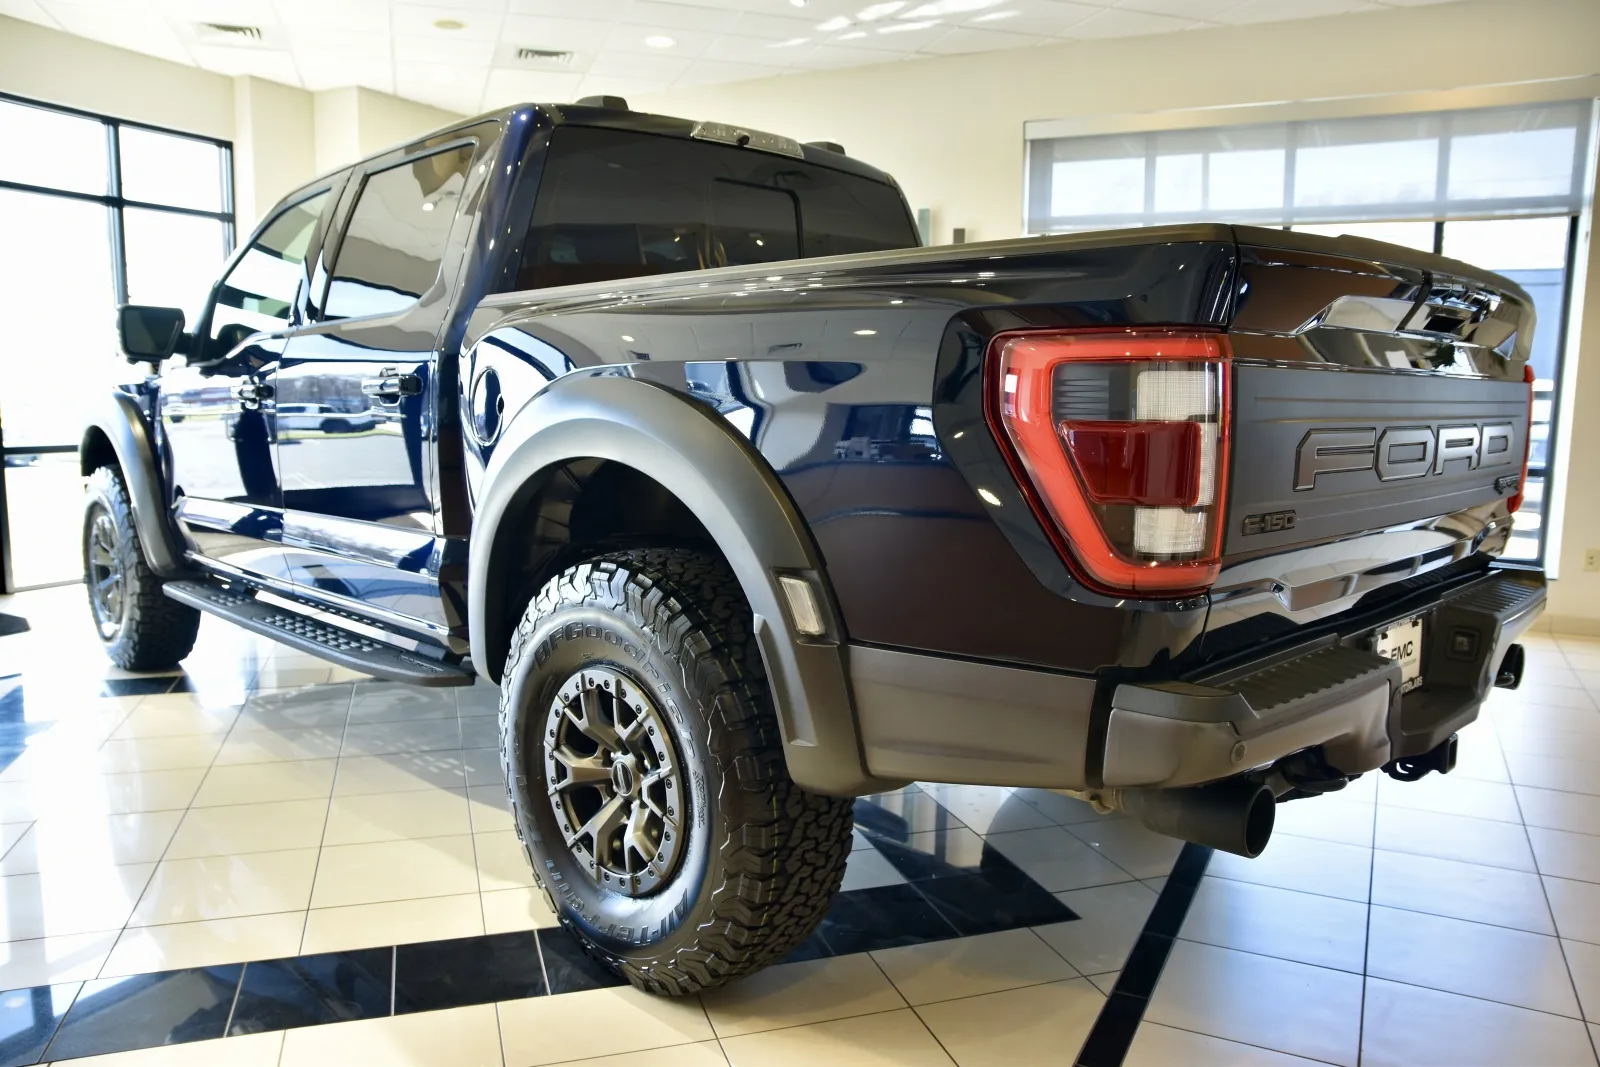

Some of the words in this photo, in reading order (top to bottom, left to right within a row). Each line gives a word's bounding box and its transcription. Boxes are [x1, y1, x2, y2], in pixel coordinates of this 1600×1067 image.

[1293, 421, 1514, 492] FORD
[1242, 509, 1296, 536] F-150
[1390, 640, 1413, 661] EMC
